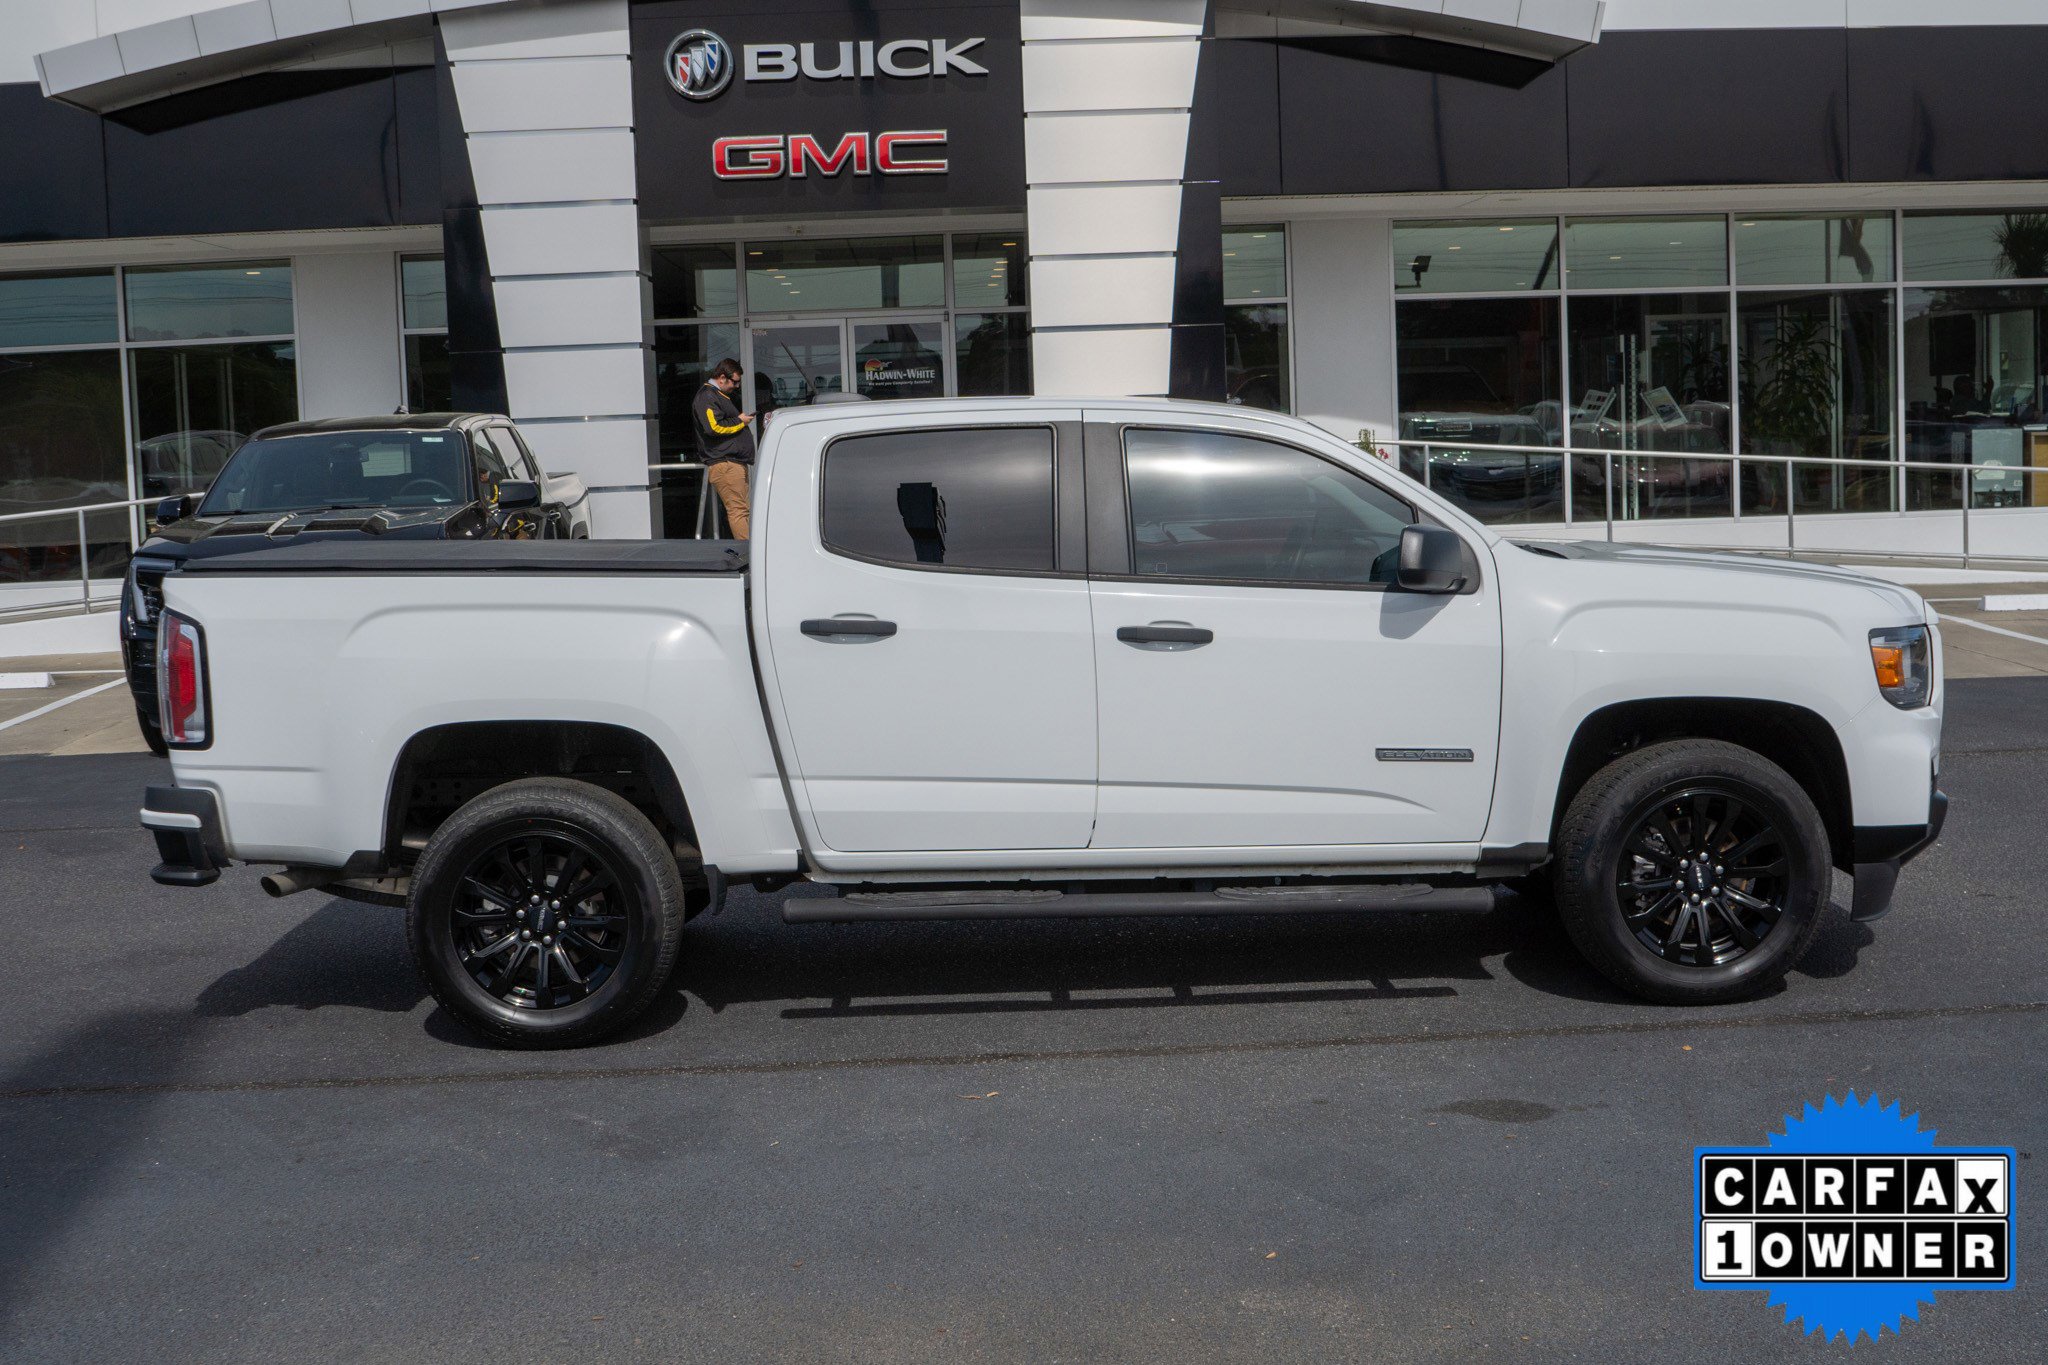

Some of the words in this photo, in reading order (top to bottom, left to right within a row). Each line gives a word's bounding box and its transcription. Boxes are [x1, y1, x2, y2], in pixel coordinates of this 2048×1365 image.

[743, 37, 989, 81] BUICK
[712, 129, 949, 181] GMC
[866, 369, 935, 380] HADWIN-WHITE
